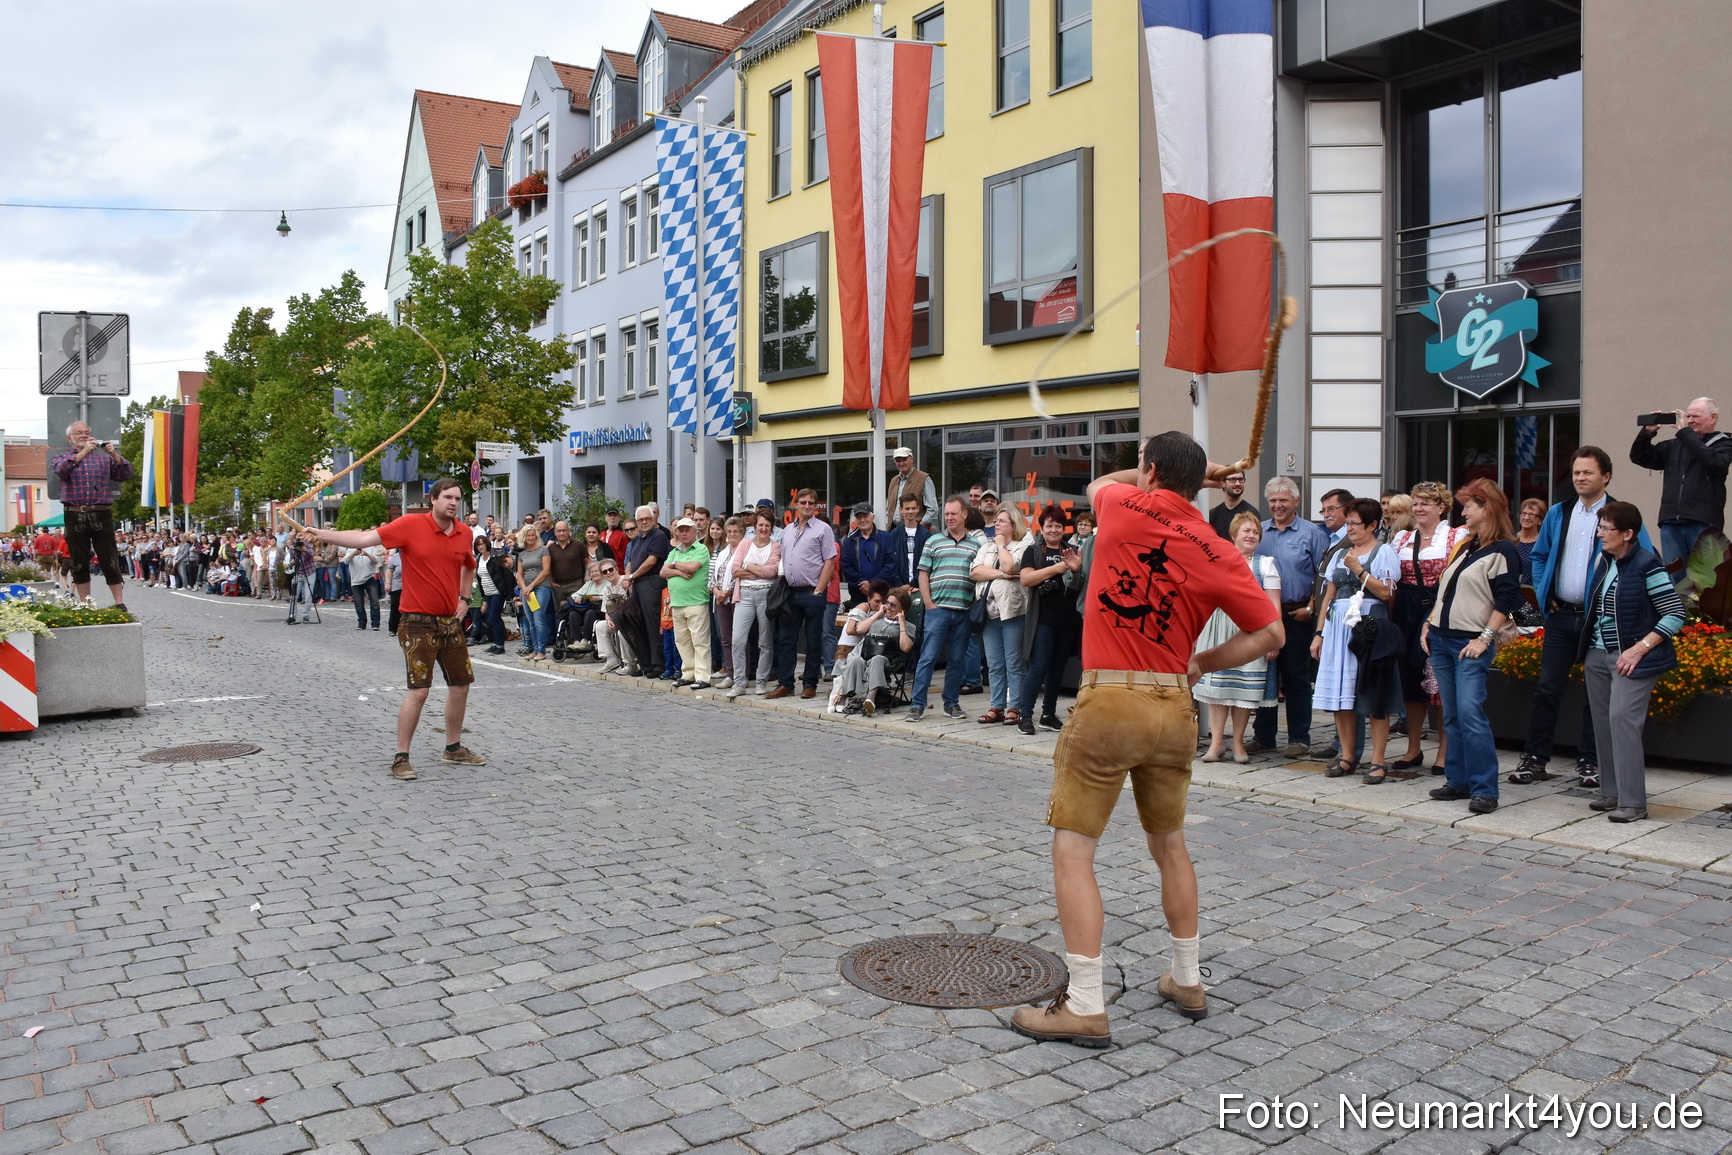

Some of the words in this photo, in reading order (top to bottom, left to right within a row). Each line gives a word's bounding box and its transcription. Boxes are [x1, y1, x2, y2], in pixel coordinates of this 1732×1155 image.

[1456, 308, 1504, 371] G2
[63, 373, 108, 387] ZOE
[583, 421, 649, 447] Raiffeisenbank
